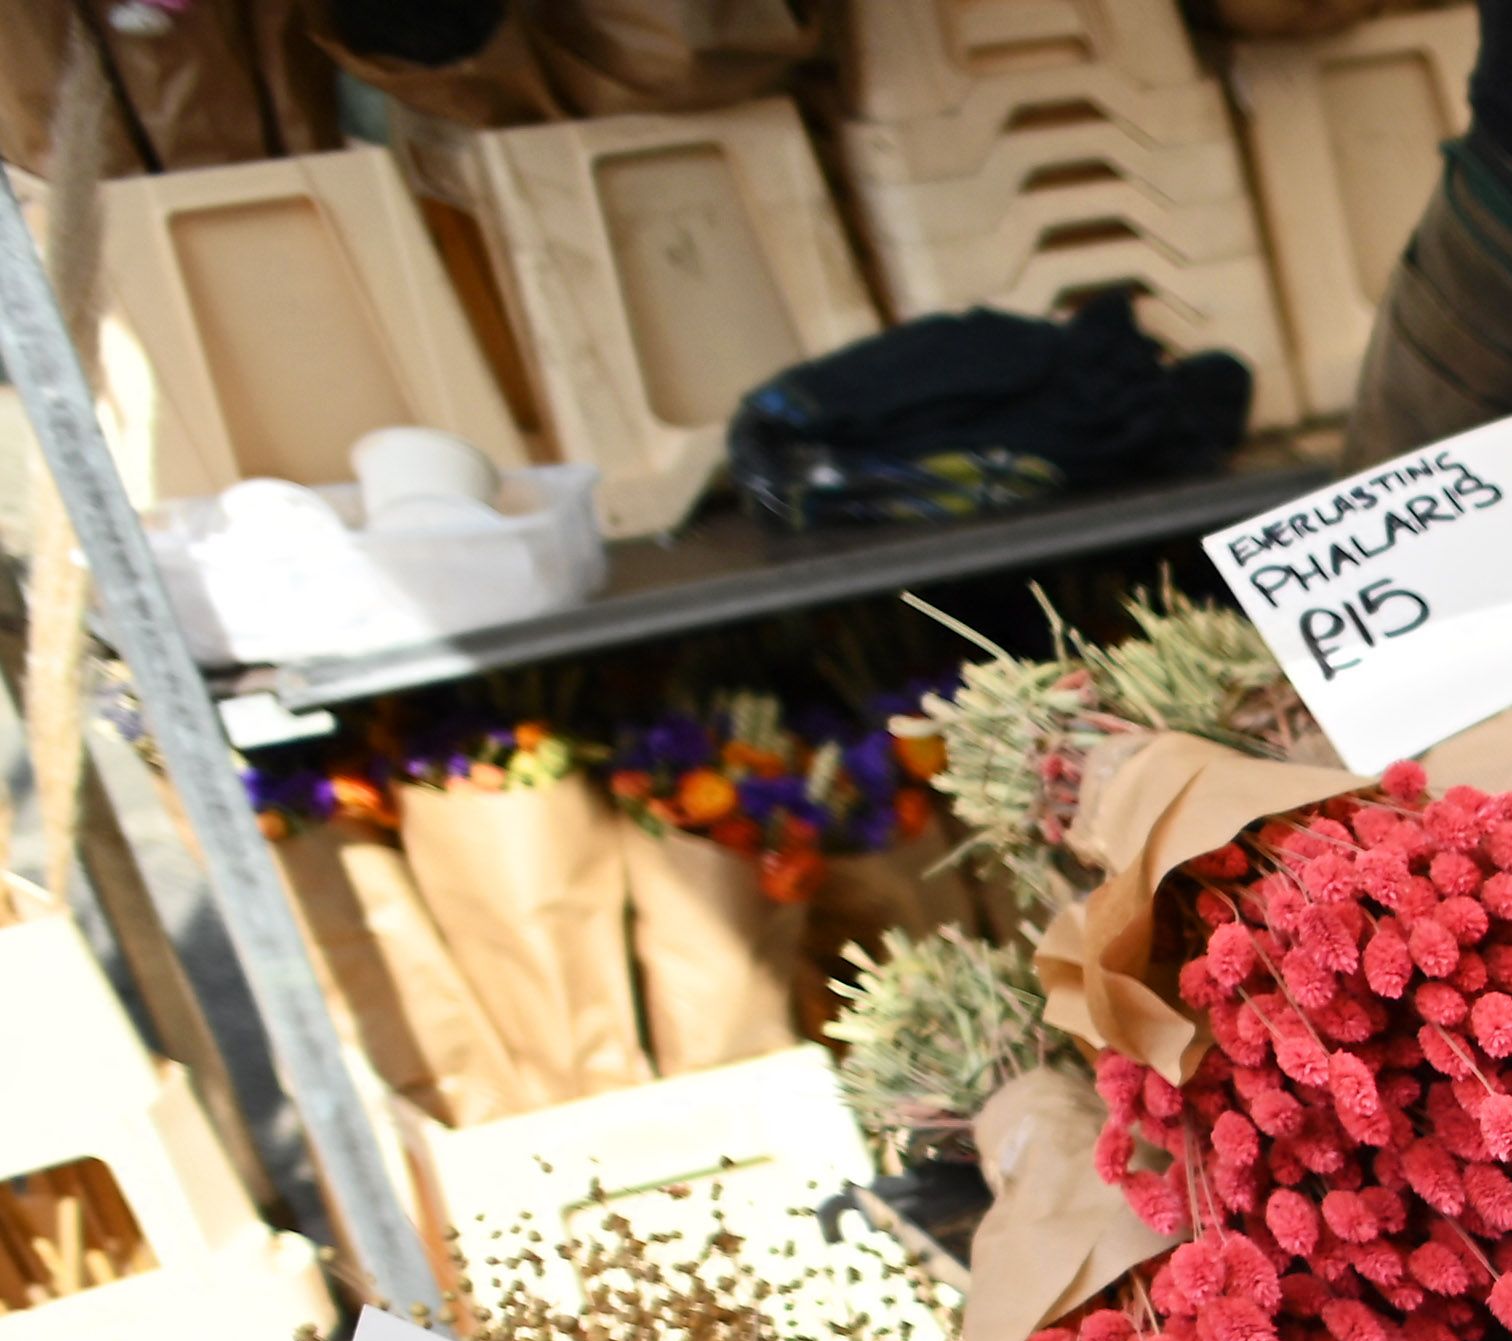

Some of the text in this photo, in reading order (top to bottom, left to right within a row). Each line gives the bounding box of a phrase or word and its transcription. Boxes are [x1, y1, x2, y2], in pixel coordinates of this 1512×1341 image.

[1228, 451, 1468, 566] EVERLASTING
[1250, 476, 1503, 608] PHALARIS
[1299, 578, 1431, 681] £15
